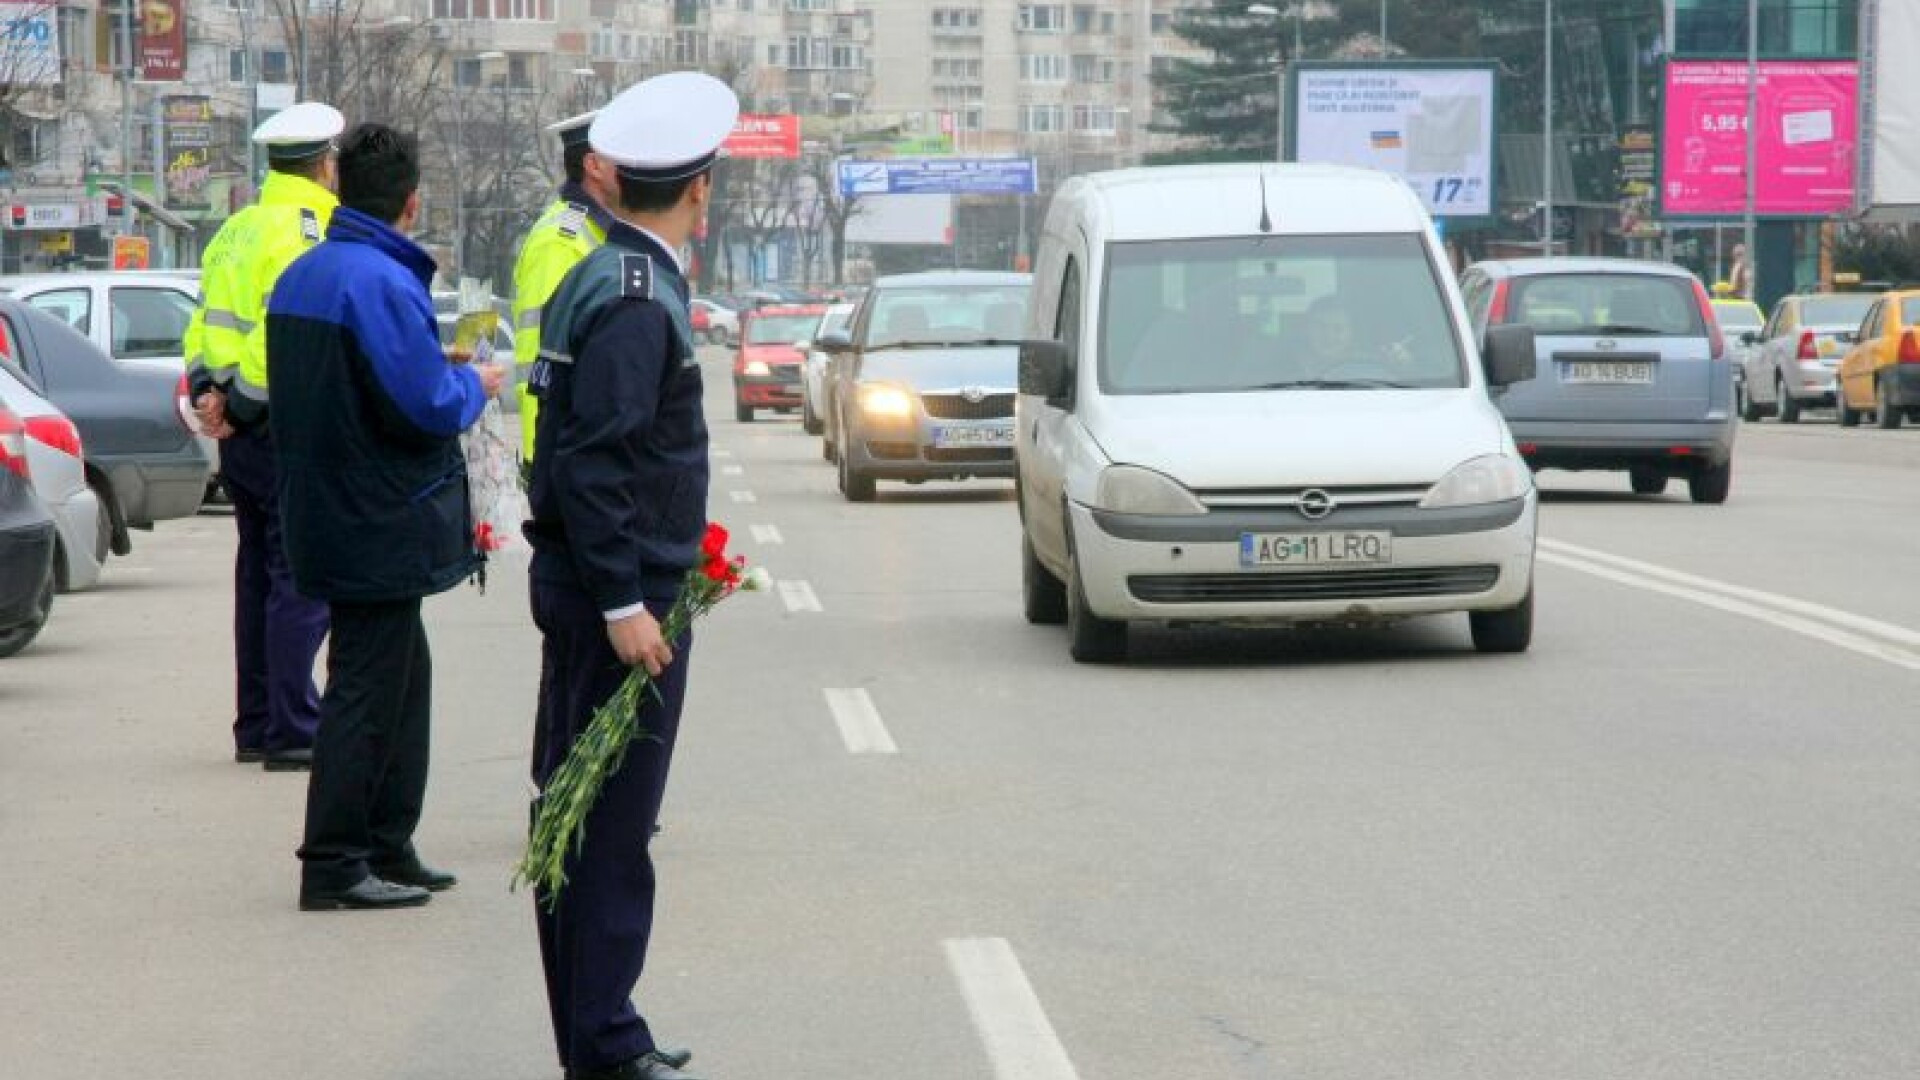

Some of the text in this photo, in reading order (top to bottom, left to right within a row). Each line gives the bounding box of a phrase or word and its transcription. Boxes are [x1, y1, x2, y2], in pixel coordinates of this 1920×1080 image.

[1432, 177, 1463, 203] 17
[1259, 536, 1290, 560] AG
[1303, 536, 1319, 560] 11
